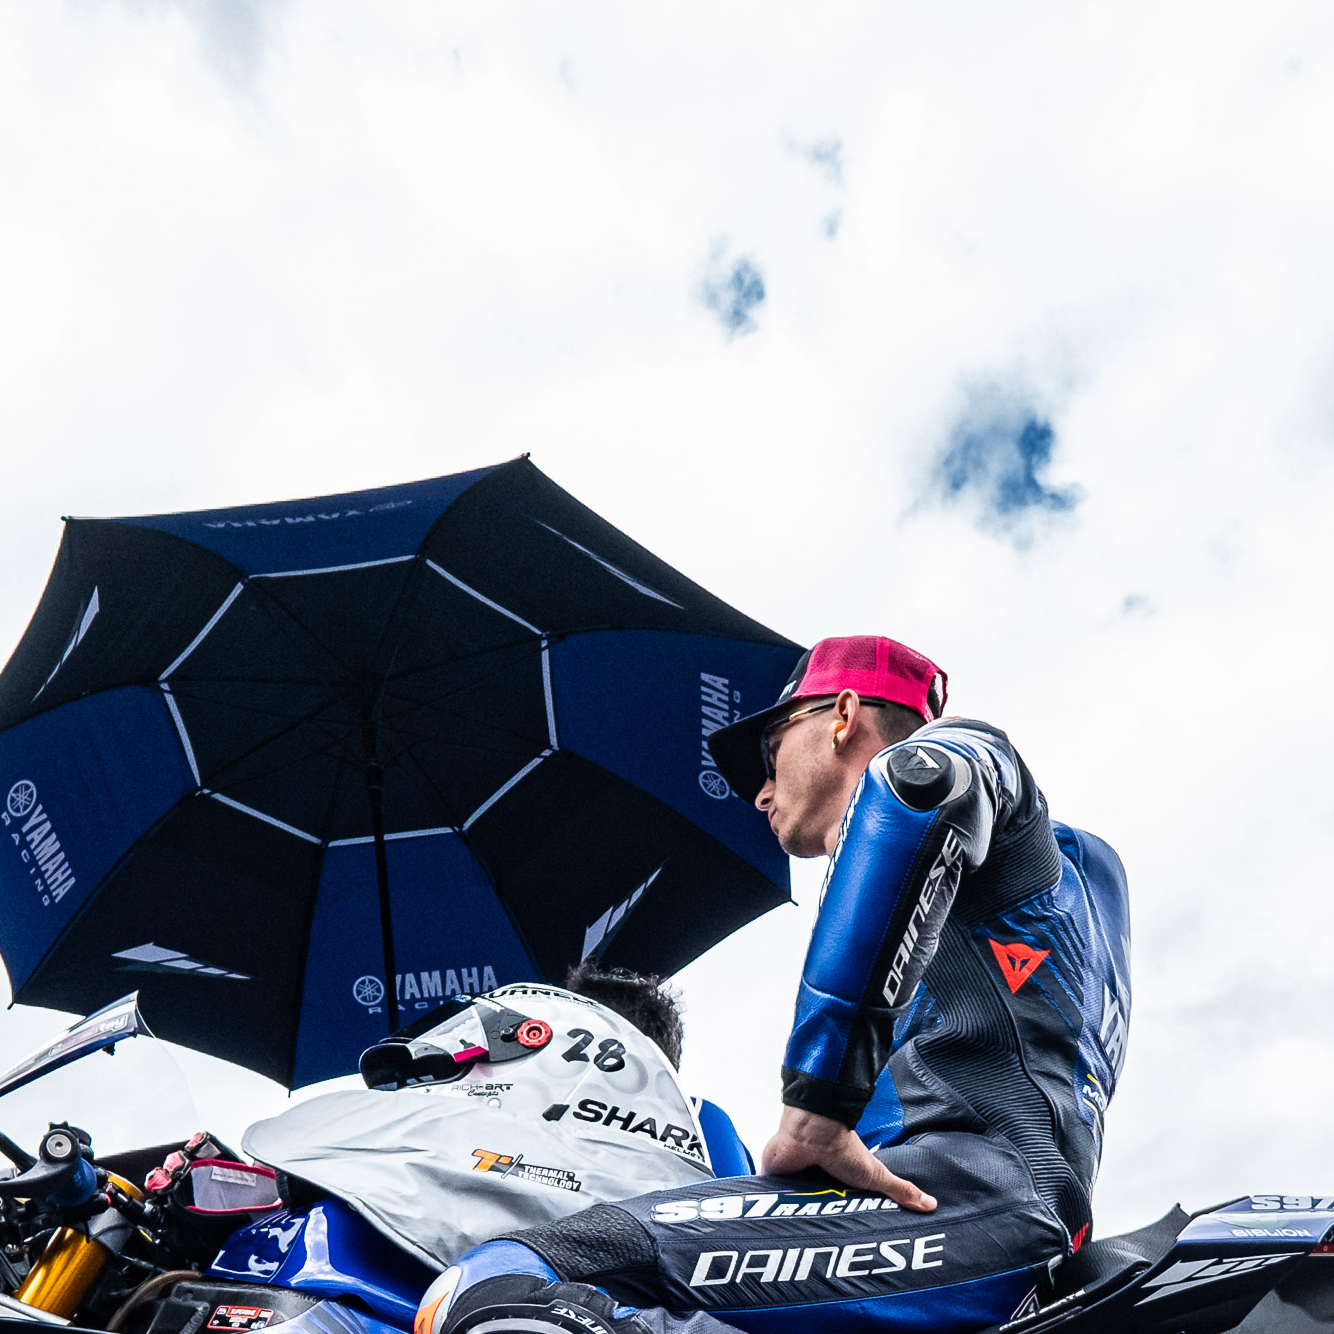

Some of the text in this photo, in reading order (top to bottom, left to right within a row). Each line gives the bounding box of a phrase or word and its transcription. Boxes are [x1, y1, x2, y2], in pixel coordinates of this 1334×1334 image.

[700, 672, 730, 768] YMAHA
[0, 810, 51, 907] RACING
[21, 803, 76, 904] YAMAHA
[881, 827, 964, 1008] DAINESE
[561, 1027, 627, 1074] 28
[572, 1097, 705, 1162] SHARK
[663, 1142, 705, 1163] HELMET
[517, 1171, 582, 1192] TECHNOLOGY
[523, 1164, 576, 1183] THERMAL
[688, 1232, 947, 1288] DAINESE
[1231, 1228, 1313, 1238] BIBLION
